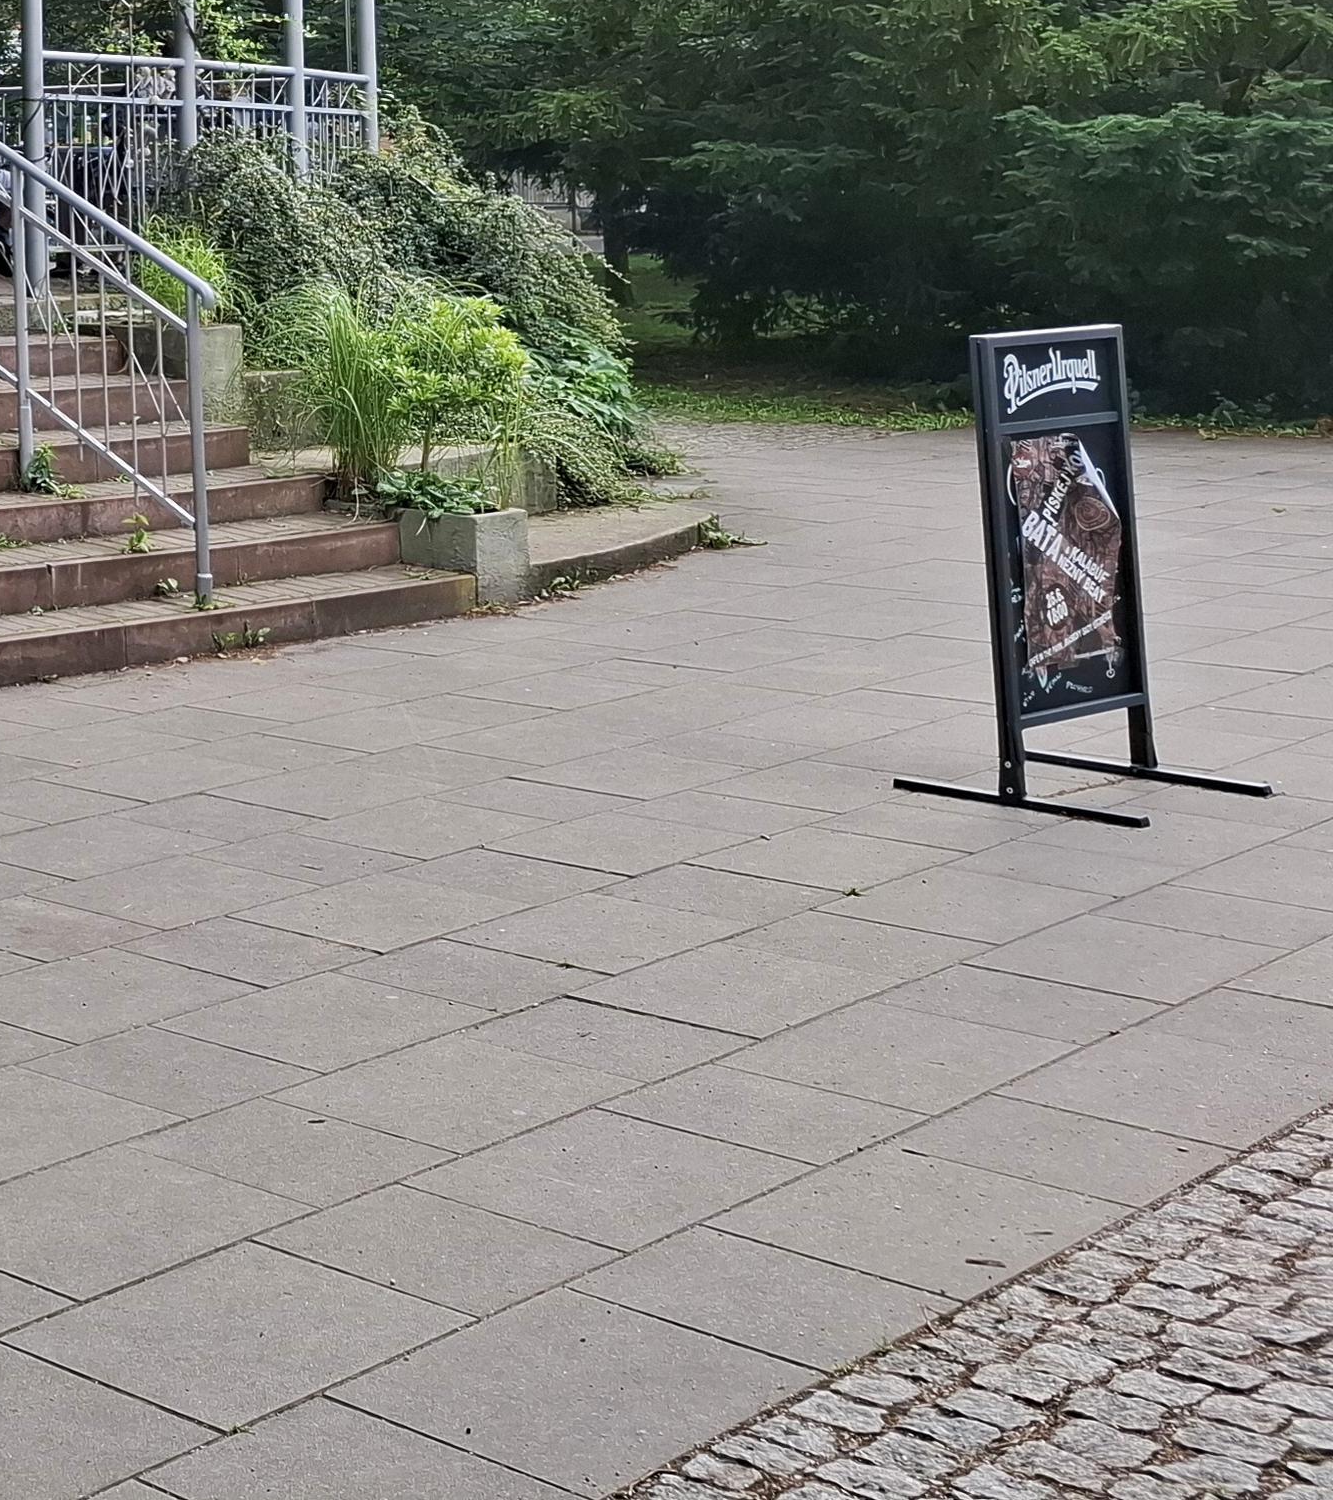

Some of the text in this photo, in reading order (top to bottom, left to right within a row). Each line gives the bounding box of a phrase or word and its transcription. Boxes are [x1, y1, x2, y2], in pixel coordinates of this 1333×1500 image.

[1003, 347, 1098, 414] Pilsner Urquell
[1022, 509, 1064, 563] BATA
